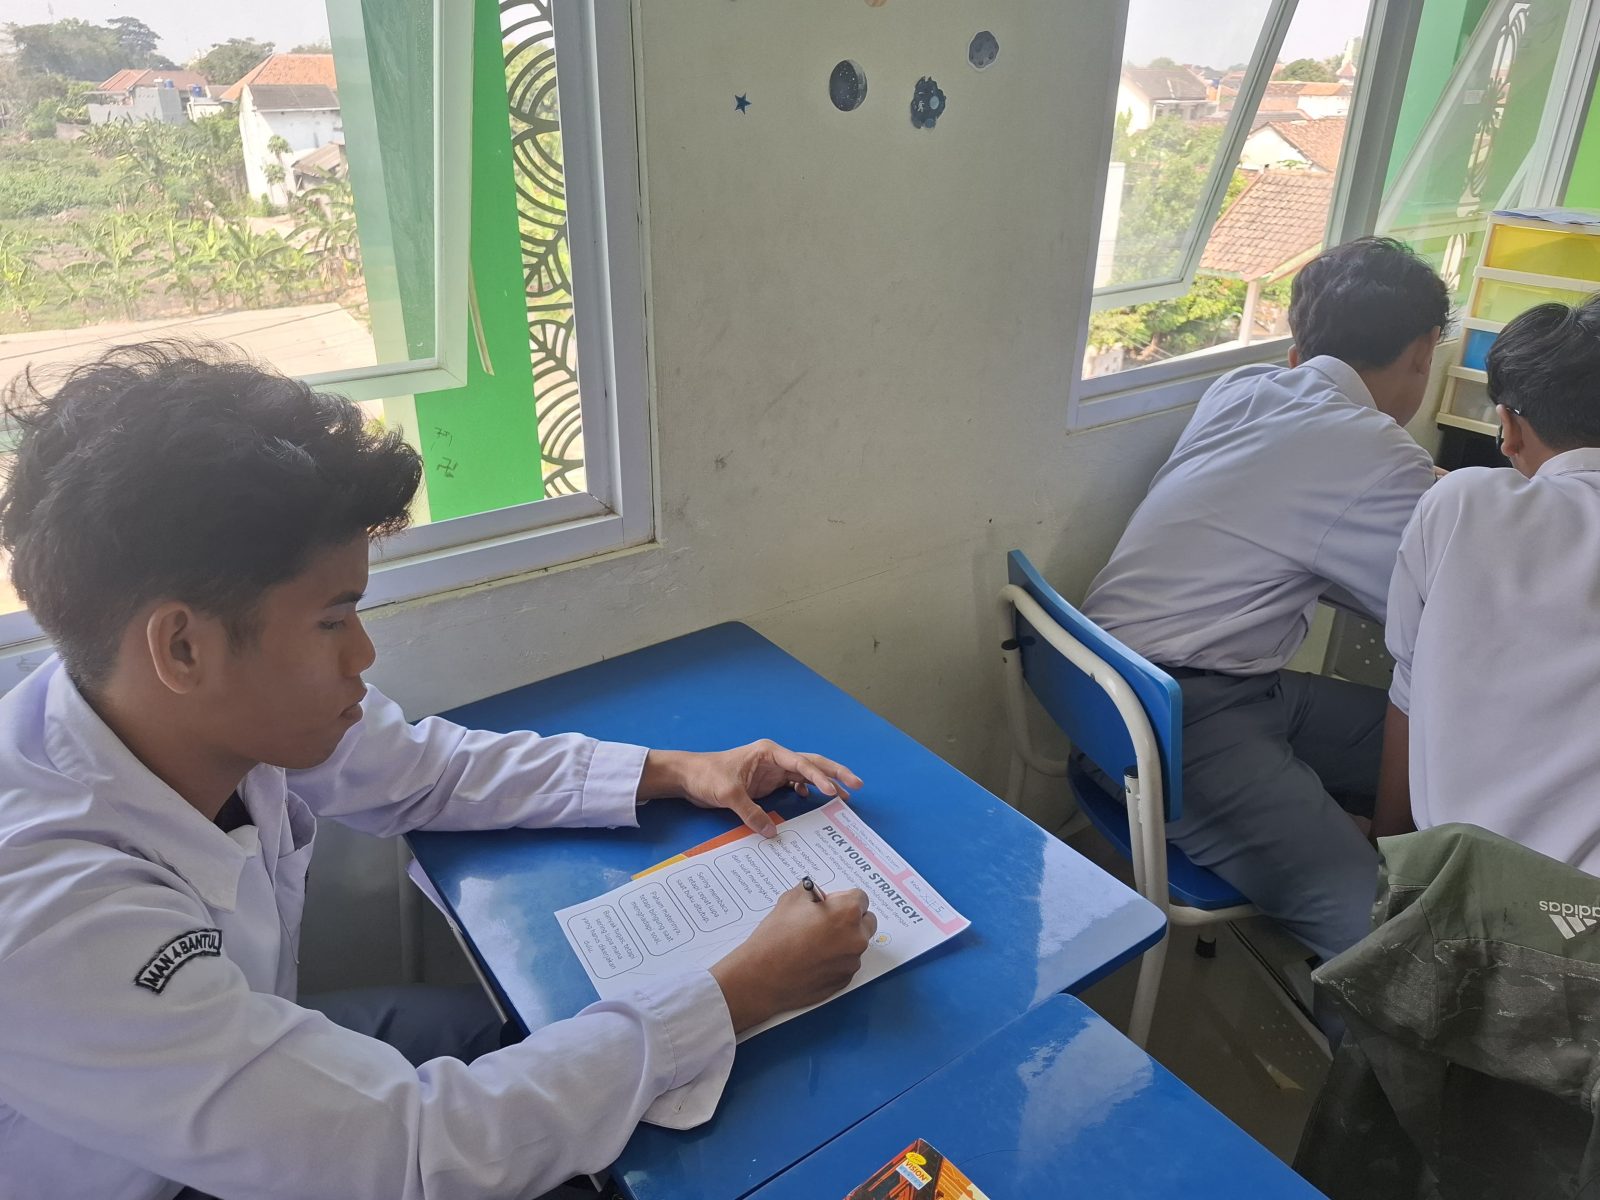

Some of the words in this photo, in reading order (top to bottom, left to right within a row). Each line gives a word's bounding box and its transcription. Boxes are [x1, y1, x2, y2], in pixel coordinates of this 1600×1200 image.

[694, 871, 713, 888] Sering
[821, 825, 847, 846] PICK
[842, 846, 873, 872] YOUR
[867, 872, 924, 924] STRATEGY!
[683, 889, 696, 903] buku
[686, 875, 702, 891] tetapi
[696, 890, 712, 906] cepat
[707, 904, 721, 918] lupa
[1539, 900, 1600, 919] adidas
[144, 953, 174, 987] MAN
[173, 946, 182, 959] 4
[179, 933, 218, 954] BANTUL
[905, 1161, 927, 1181] VISION
